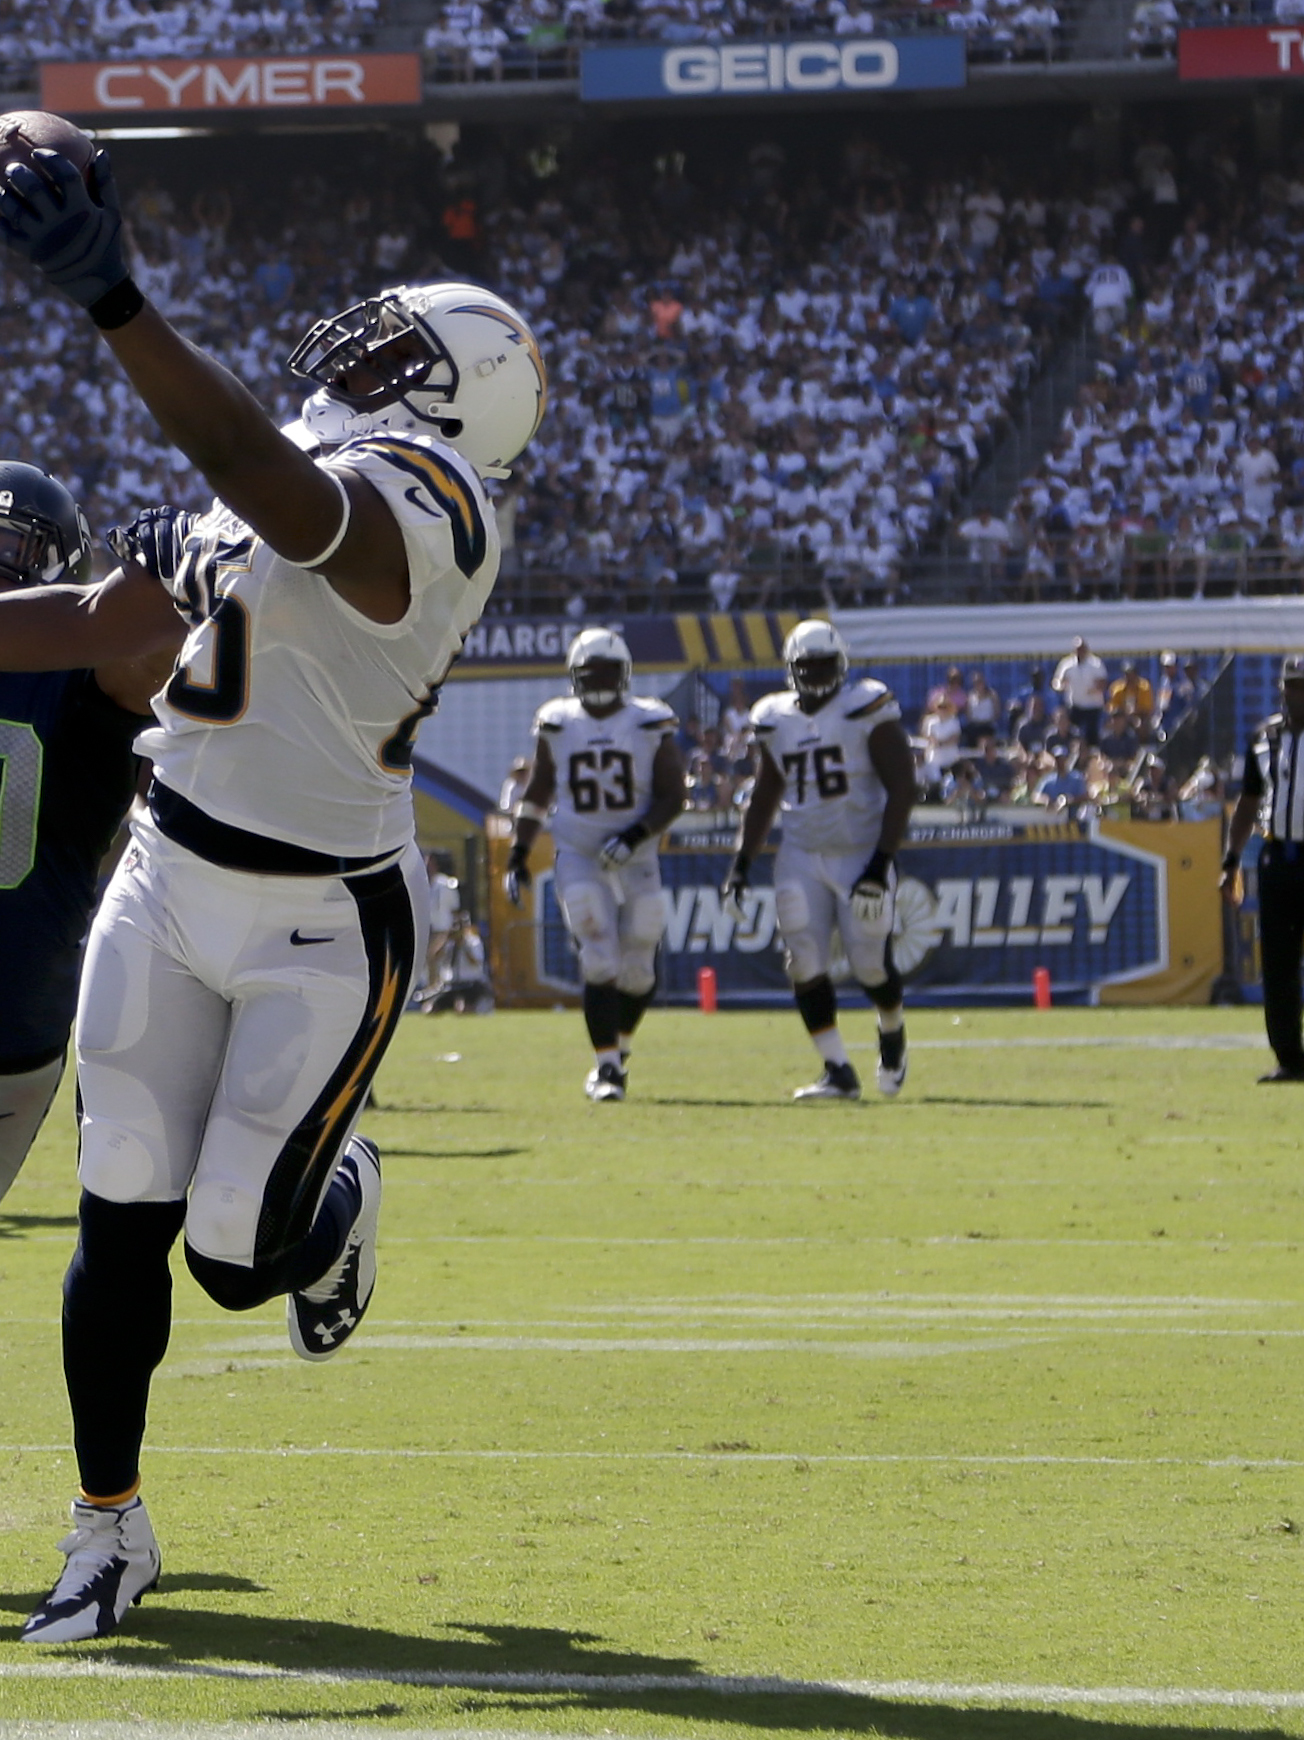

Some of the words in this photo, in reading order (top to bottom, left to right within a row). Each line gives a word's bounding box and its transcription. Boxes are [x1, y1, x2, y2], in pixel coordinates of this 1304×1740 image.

[95, 60, 365, 108] CYMER
[663, 40, 898, 94] GEICO
[569, 750, 635, 814] 63
[783, 745, 848, 805] 76
[923, 875, 1131, 949] ALLEY
